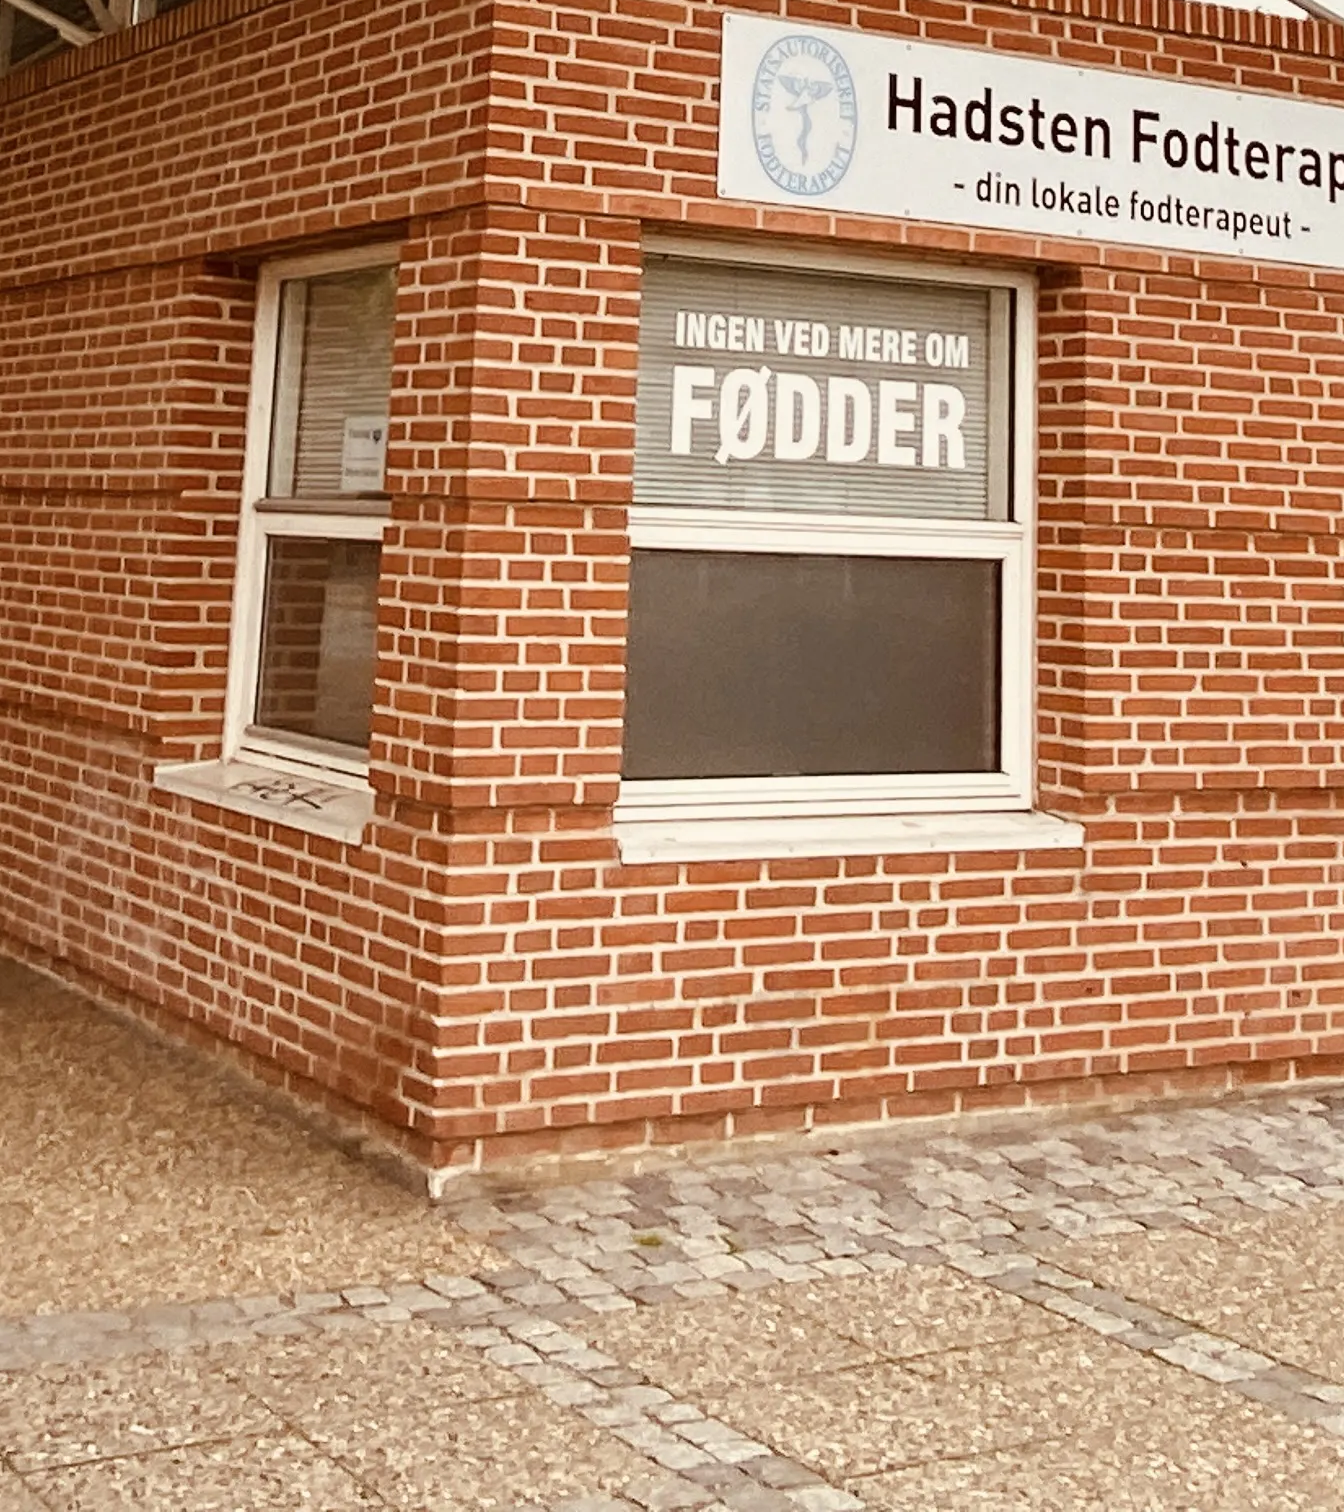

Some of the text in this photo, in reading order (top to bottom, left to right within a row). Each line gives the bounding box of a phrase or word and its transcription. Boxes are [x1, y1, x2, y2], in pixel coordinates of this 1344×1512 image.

[756, 37, 855, 122] STATSAUTORISERET
[887, 72, 1111, 159] Hadsten
[757, 132, 851, 194] FODTERAPEUT
[976, 171, 1020, 207] din
[1031, 176, 1120, 218] lokale
[1130, 190, 1292, 240] fodterapeut
[675, 311, 969, 369] INGEN VED MERE OM
[670, 364, 967, 470] FØDDER
